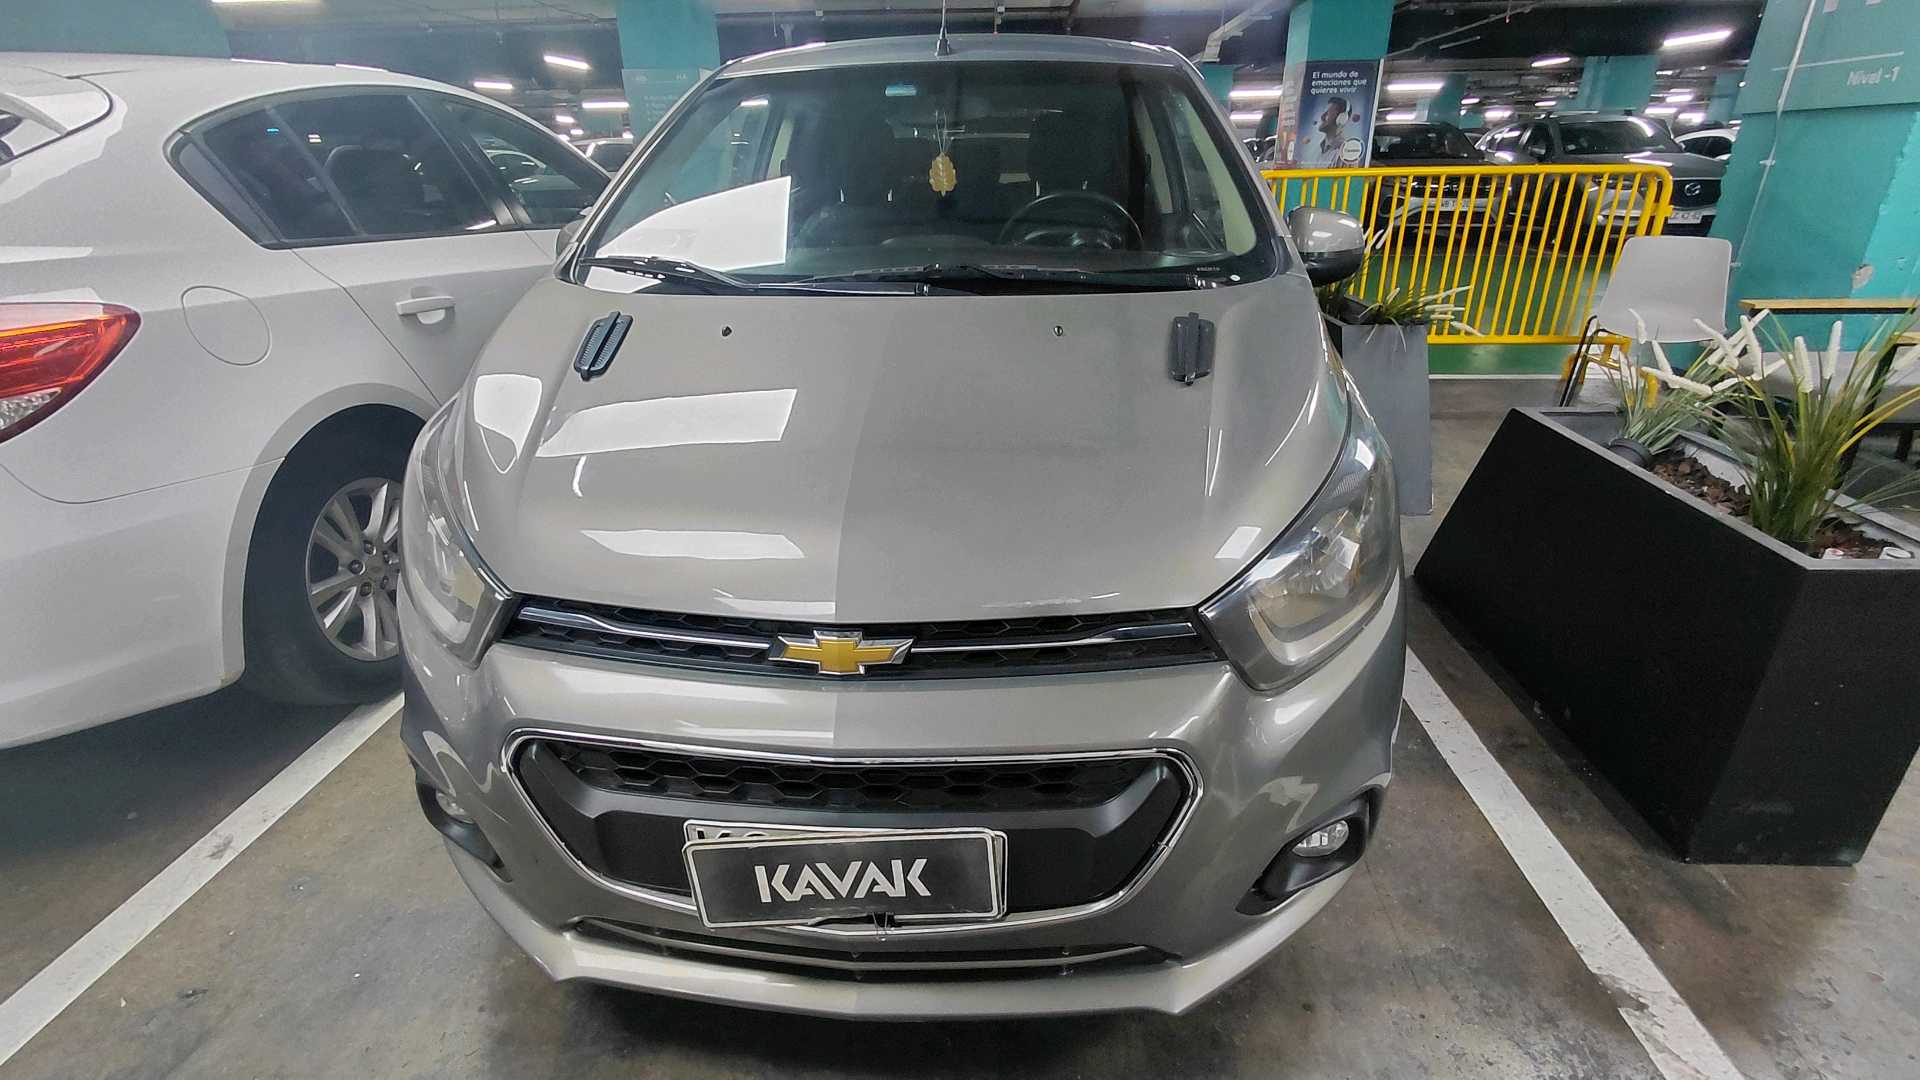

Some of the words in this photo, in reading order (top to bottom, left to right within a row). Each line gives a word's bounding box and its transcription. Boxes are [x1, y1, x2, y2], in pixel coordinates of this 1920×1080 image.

[1321, 70, 1348, 78] mundo
[1349, 70, 1359, 78] de
[1846, 67, 1882, 86] Nivel
[1884, 66, 1900, 82] -1
[1310, 87, 1338, 95] quieres
[754, 858, 932, 903] KAVAK
